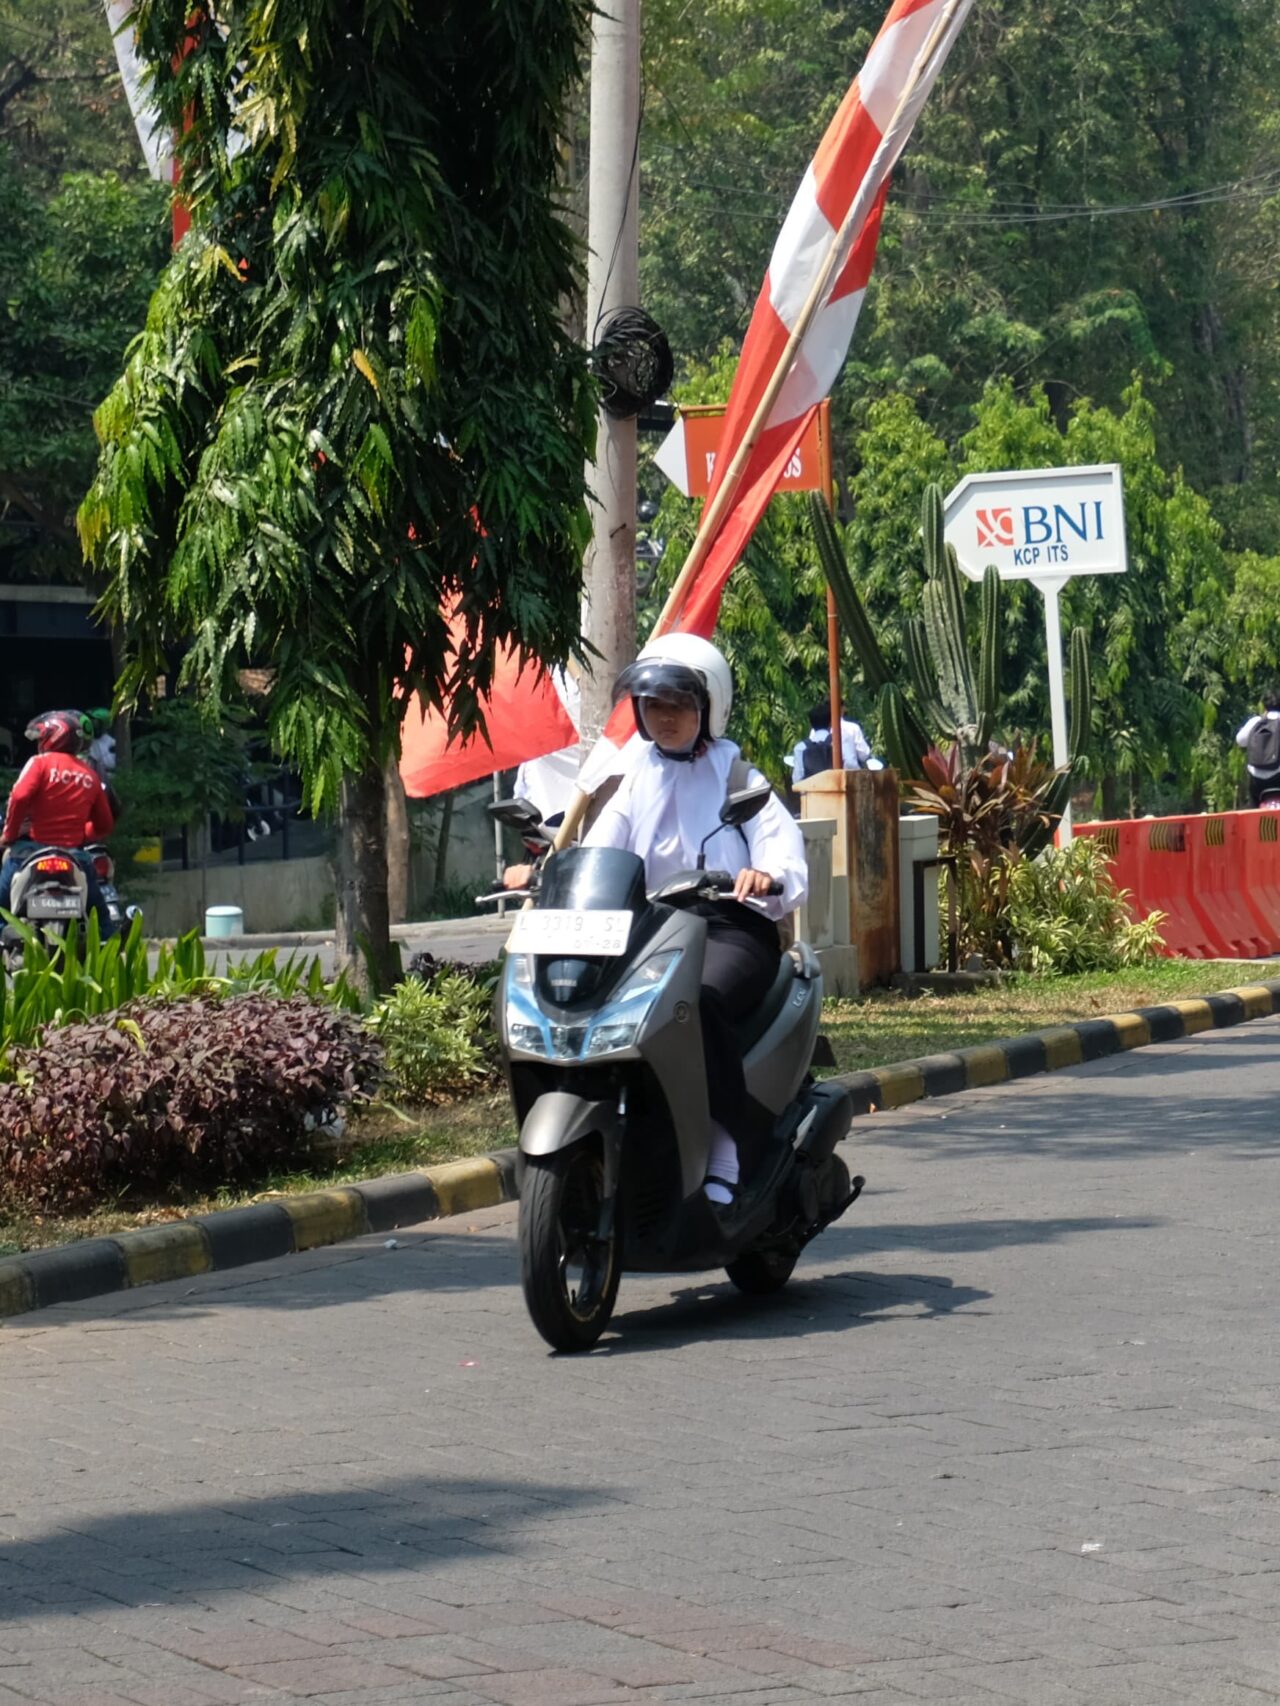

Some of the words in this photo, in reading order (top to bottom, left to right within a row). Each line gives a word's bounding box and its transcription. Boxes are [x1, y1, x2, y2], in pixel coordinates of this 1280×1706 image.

[1022, 501, 1104, 545] BNI
[1014, 548, 1040, 565] KCP
[1047, 545, 1069, 563] ITS
